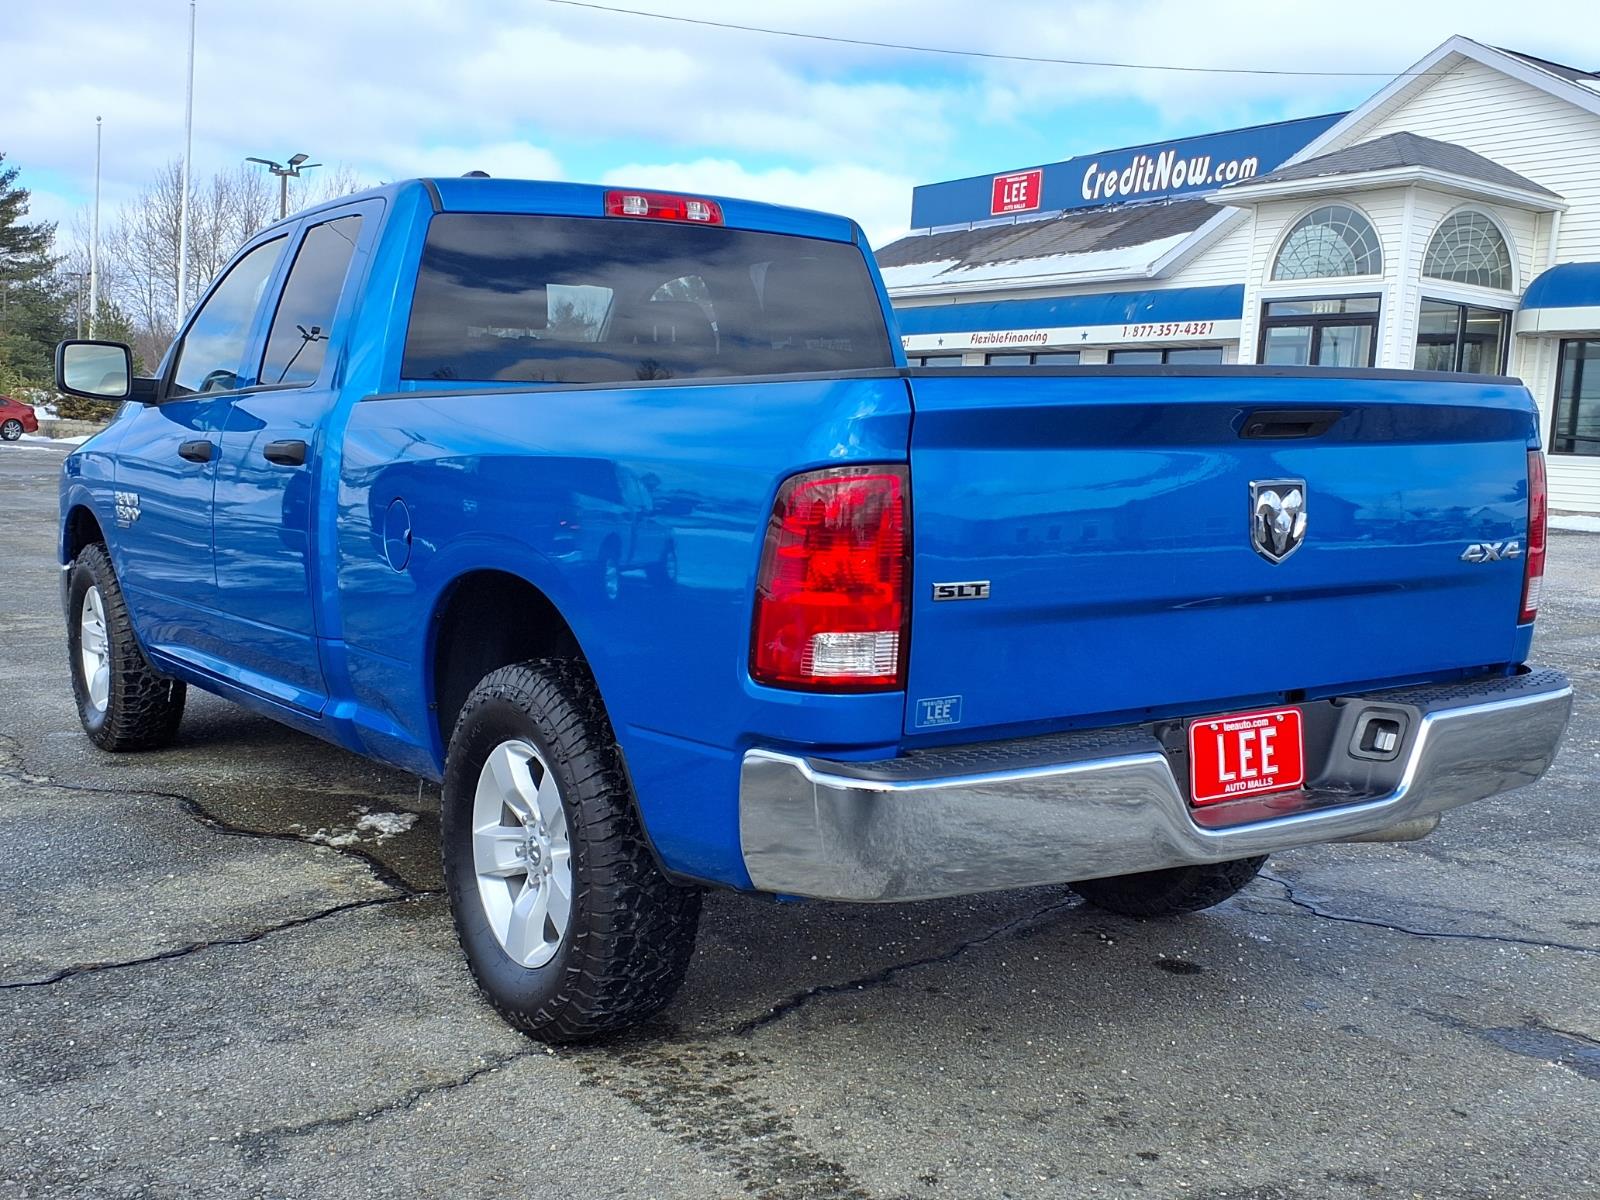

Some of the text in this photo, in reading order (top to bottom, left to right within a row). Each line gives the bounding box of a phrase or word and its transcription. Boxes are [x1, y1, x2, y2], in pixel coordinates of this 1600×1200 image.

[1081, 150, 1258, 200] CreditNow.com
[1003, 181, 1028, 203] LEE
[938, 584, 987, 598] SLT
[927, 704, 951, 720] LEE
[1223, 718, 1269, 732] leeauto.com
[1216, 726, 1279, 783] LEE
[1224, 776, 1274, 793] AUTO MALLS
